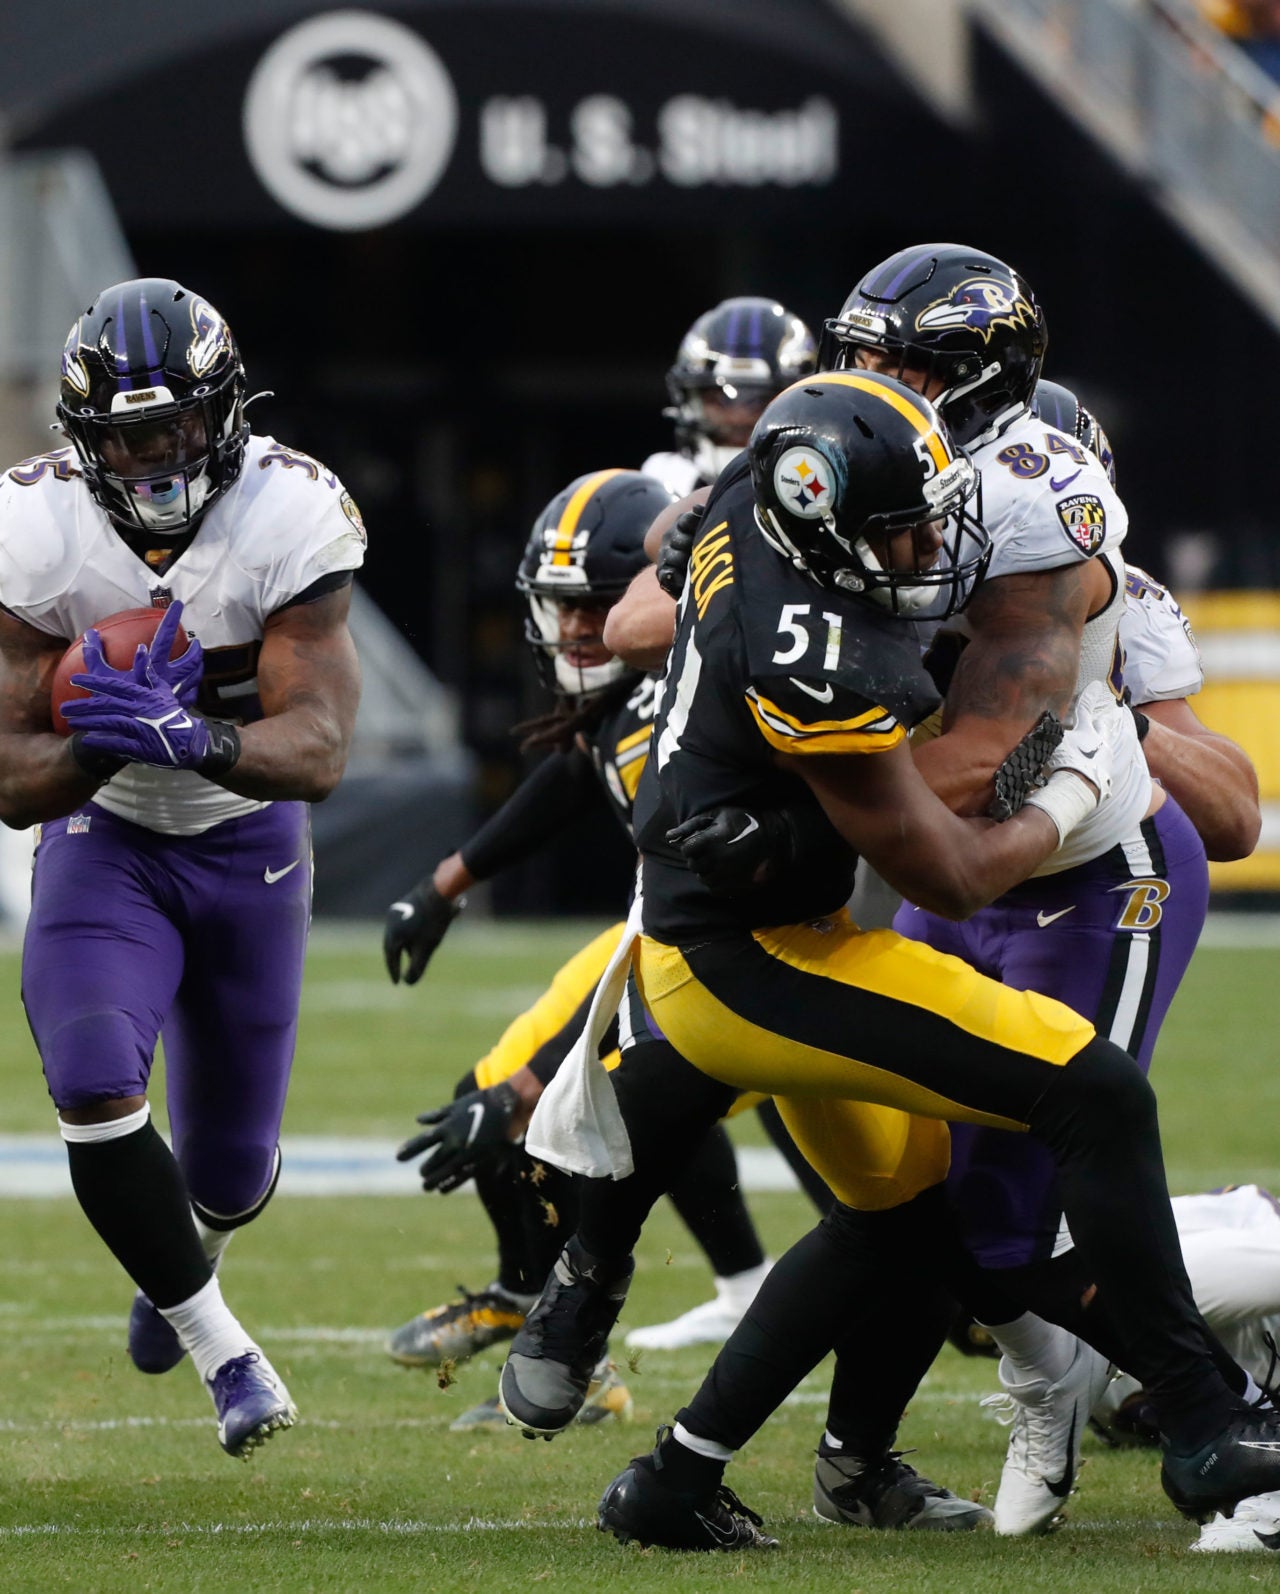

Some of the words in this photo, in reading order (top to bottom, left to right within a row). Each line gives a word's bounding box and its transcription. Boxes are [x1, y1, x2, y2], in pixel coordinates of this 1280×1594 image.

[995, 432, 1089, 480] 84
[1058, 496, 1100, 510] RAVENS
[771, 603, 843, 671] 51
[1106, 877, 1171, 930] B
[1200, 1452, 1219, 1476] VAPOR
